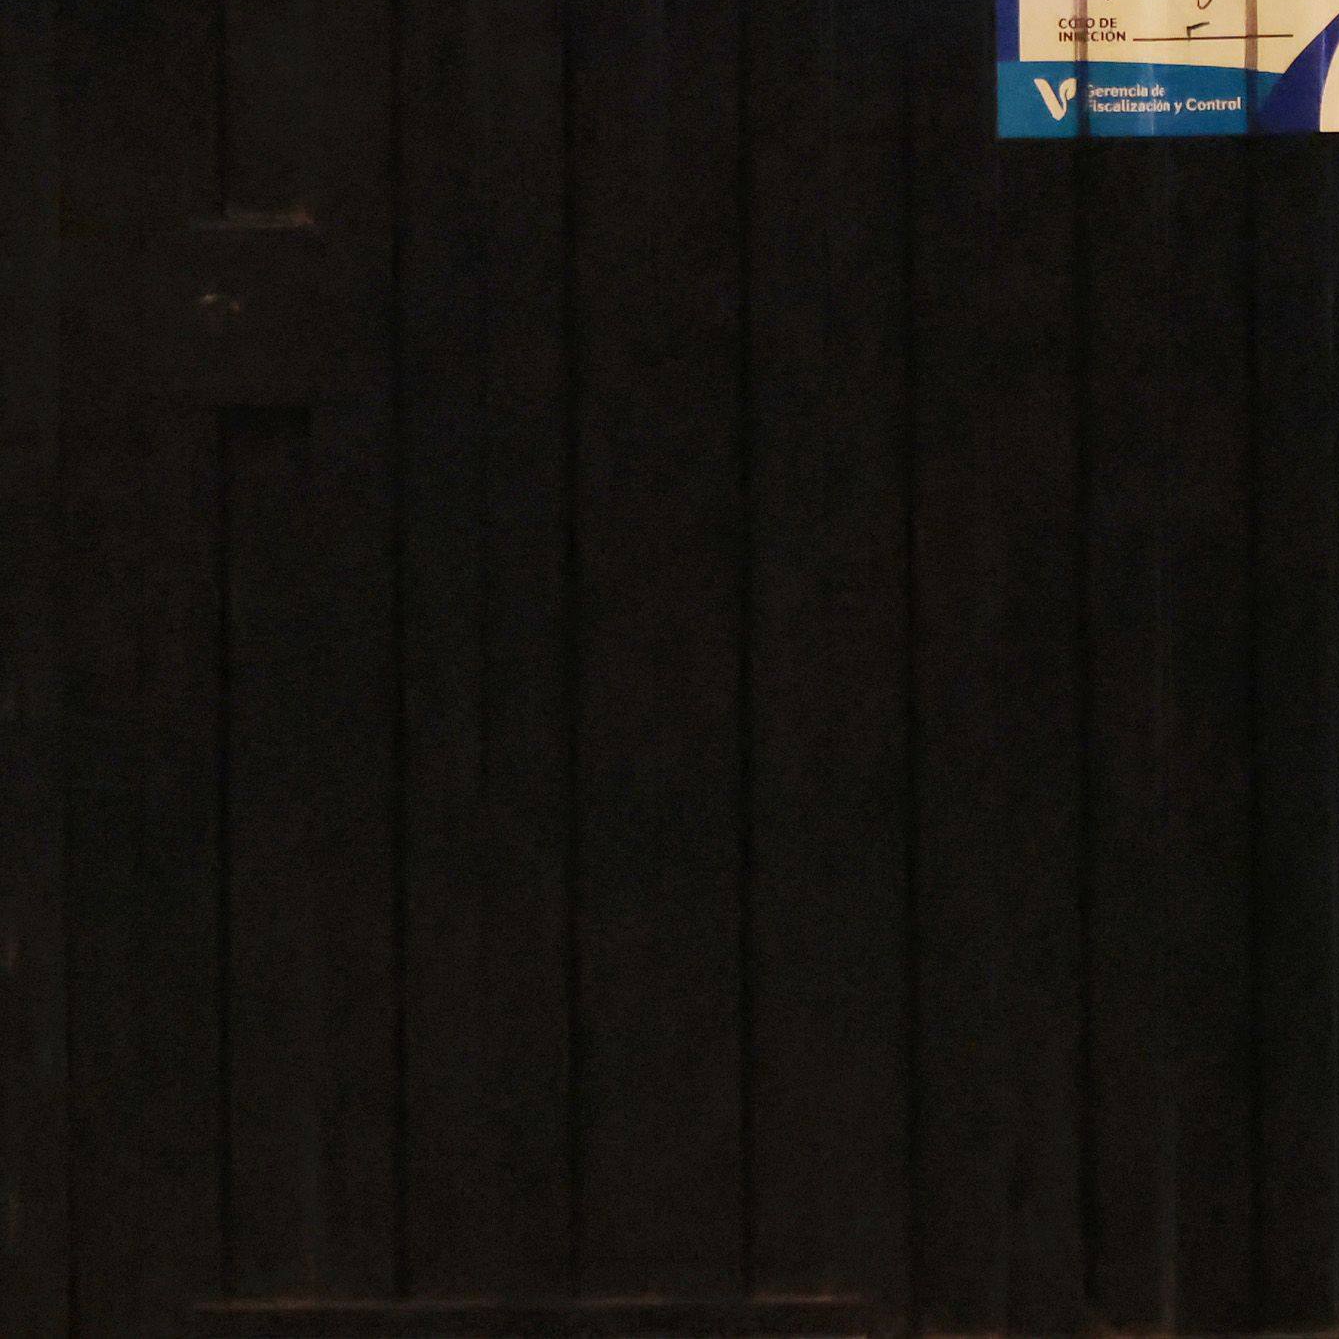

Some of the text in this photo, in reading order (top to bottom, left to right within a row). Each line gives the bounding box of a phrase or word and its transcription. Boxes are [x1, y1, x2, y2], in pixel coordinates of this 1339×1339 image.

[1099, 17, 1117, 29] DE
[1174, 101, 1182, 115] y
[1186, 96, 1242, 112] Control
